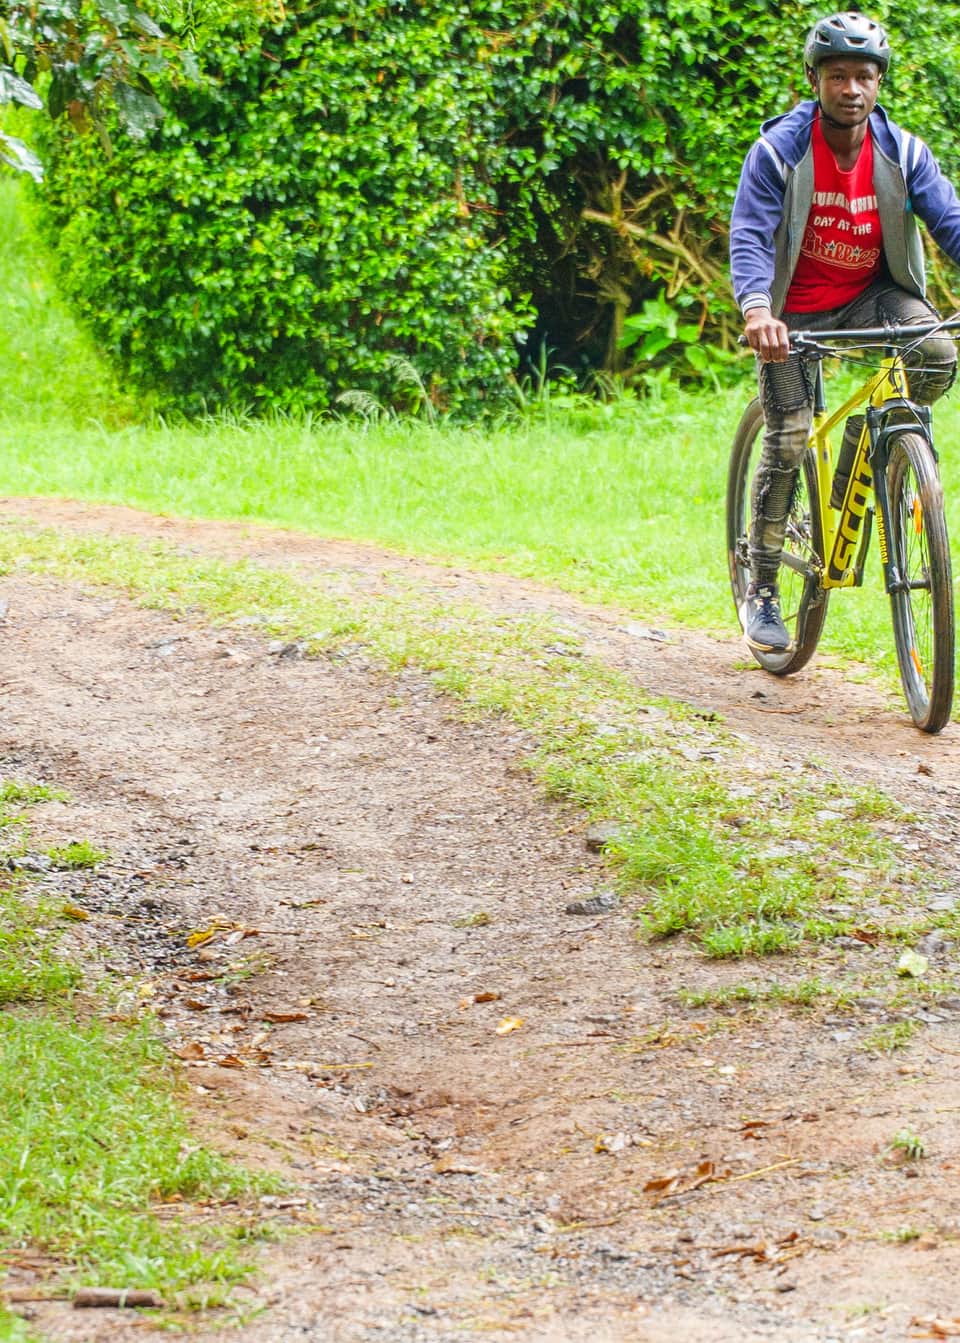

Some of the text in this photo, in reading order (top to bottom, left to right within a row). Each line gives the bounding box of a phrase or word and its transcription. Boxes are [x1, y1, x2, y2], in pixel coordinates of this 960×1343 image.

[813, 215, 872, 235] DAY AT THE
